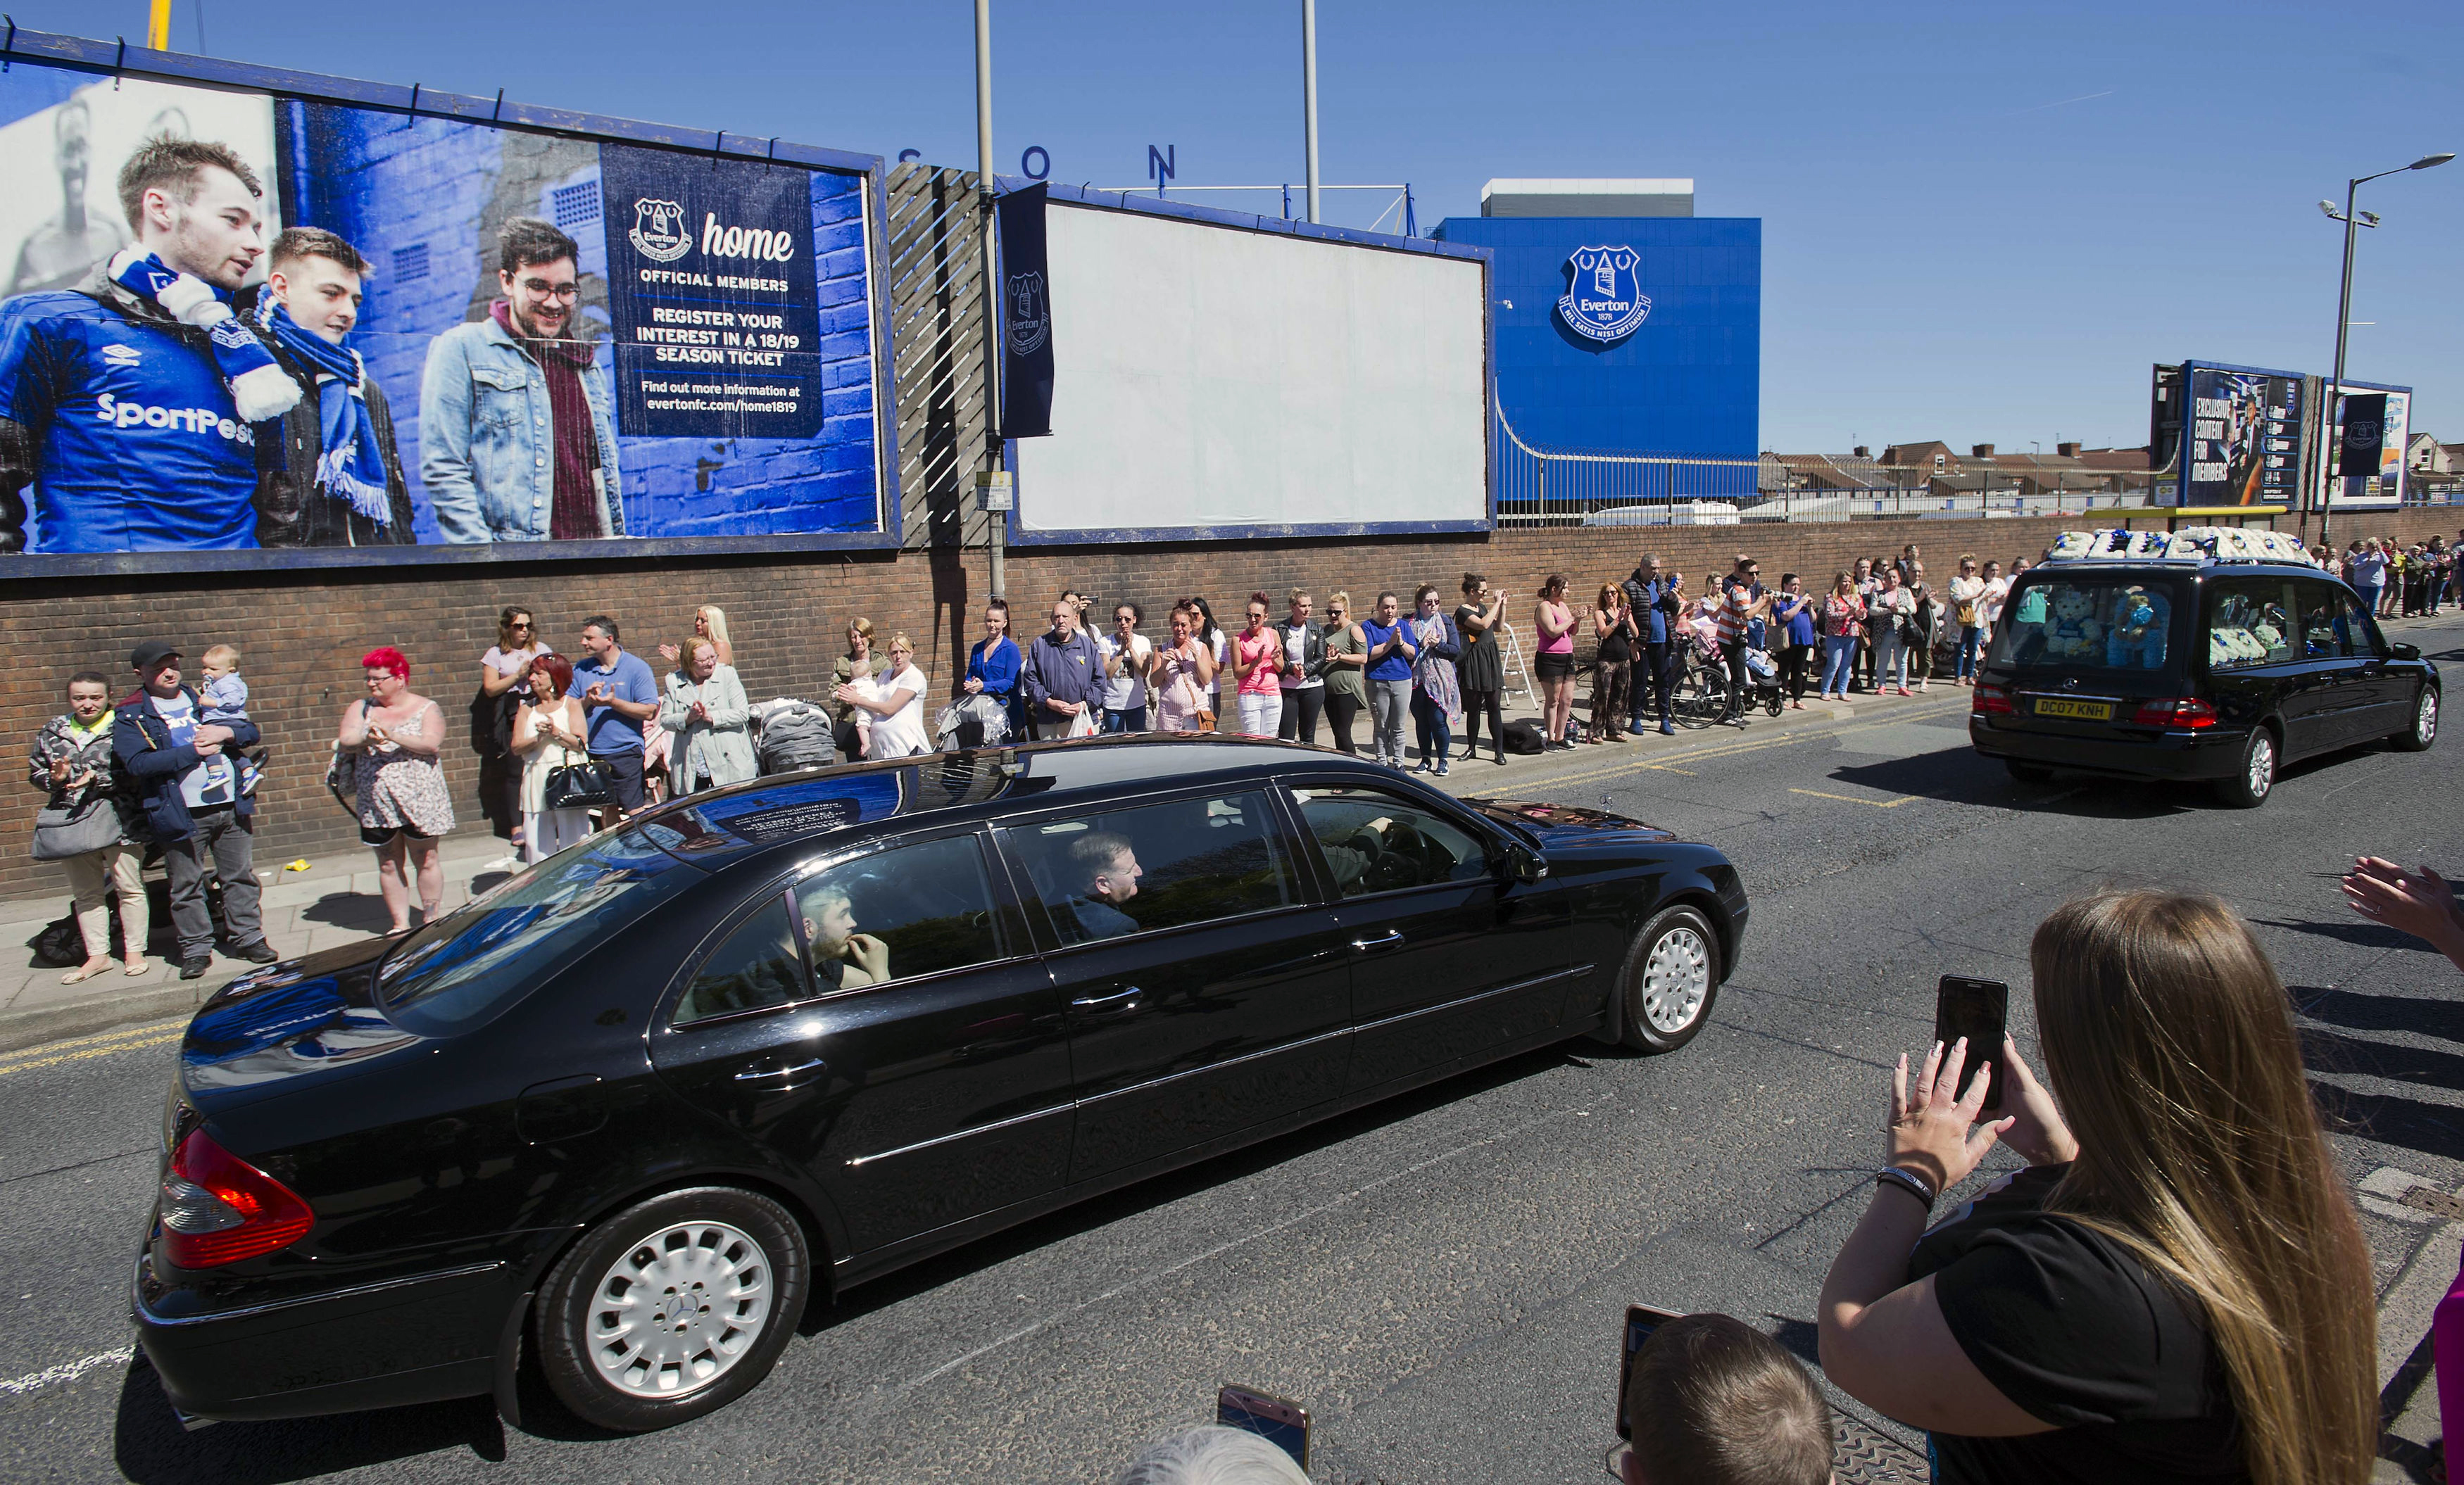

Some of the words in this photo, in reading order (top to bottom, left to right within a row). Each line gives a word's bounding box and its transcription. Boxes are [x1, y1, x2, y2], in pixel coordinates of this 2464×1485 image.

[643, 232, 678, 244] Everton
[701, 212, 794, 262] home
[639, 269, 713, 287] OFFICIAL
[717, 275, 788, 292] MEMBERS
[1581, 299, 1629, 311] Everton
[653, 308, 734, 327] REGISTER
[738, 313, 783, 329] YOUR
[1564, 309, 1574, 324] NIL
[1575, 321, 1595, 336] SATIS
[1616, 309, 1645, 335] OPTIMUM
[636, 327, 719, 346] INTEREST
[723, 332, 740, 346] IN
[744, 333, 757, 348] A
[760, 334, 800, 349] 18/19
[655, 347, 724, 364] SEASON
[727, 350, 784, 367] TICKET
[641, 381, 667, 393] Find
[670, 382, 689, 394] out
[691, 385, 722, 395] more
[724, 384, 786, 397] information
[788, 386, 800, 397] at
[647, 398, 797, 412] evertonfc.com/home1819
[2196, 398, 2232, 419] EXCLUSIVE
[2194, 419, 2224, 440] CONTENT
[2194, 440, 2208, 460] FOR
[2192, 462, 2227, 481] MEMBERS
[2040, 701, 2074, 714] DC07
[2077, 704, 2104, 716] KNH
